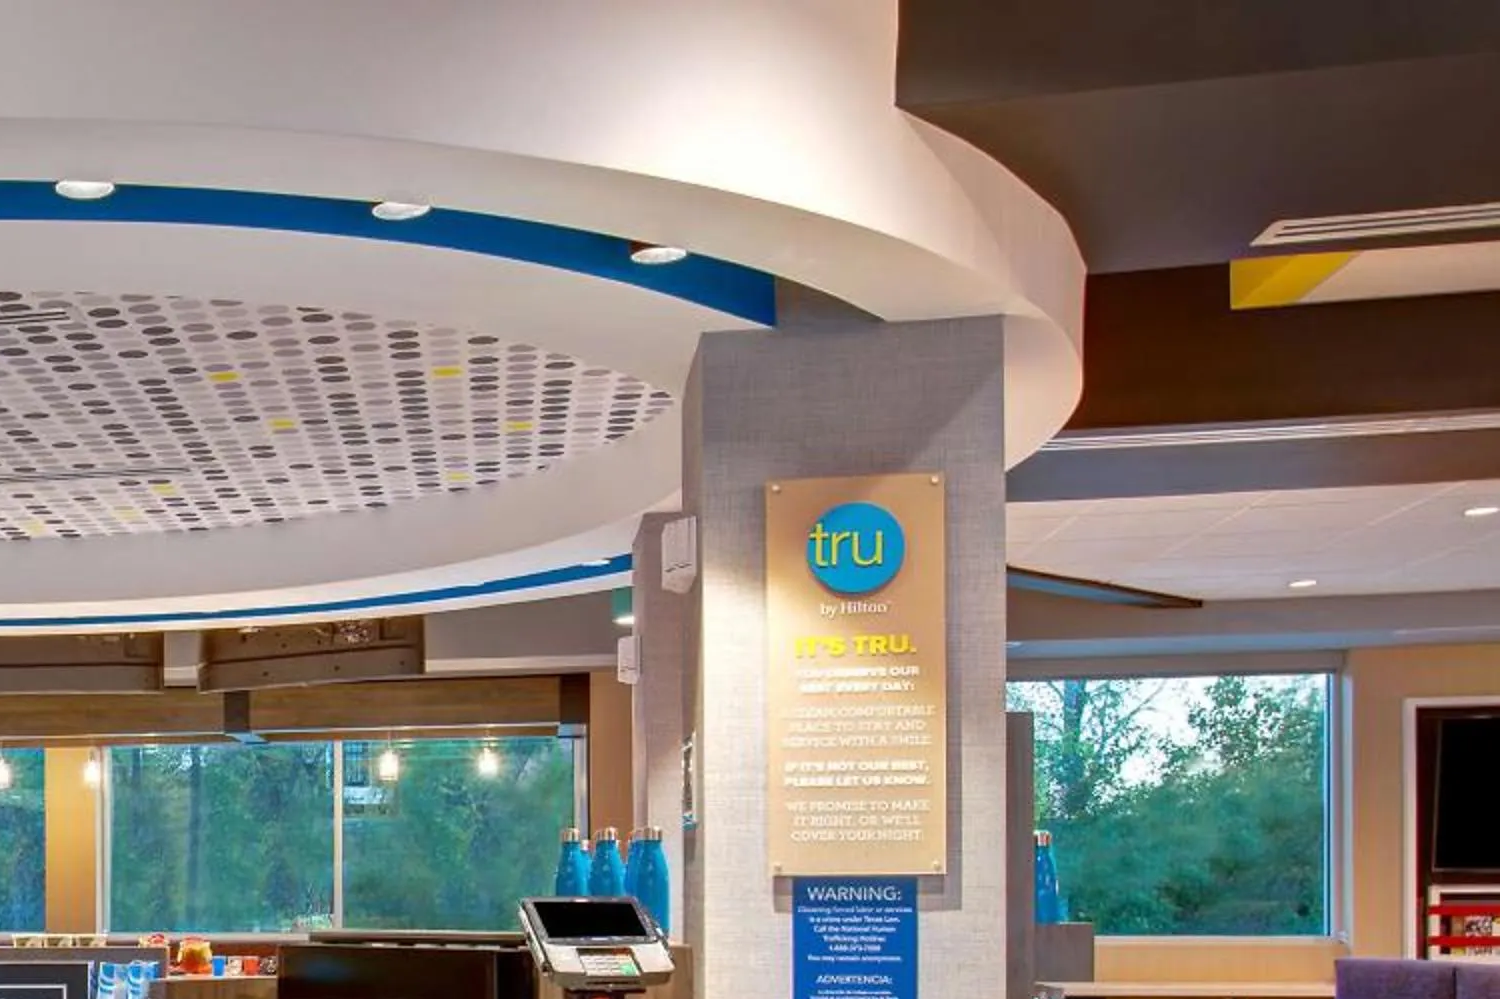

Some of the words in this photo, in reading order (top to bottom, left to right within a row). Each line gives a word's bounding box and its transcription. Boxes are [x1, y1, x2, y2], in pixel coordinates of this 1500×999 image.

[809, 523, 884, 566] tru
[820, 602, 837, 618] by
[840, 600, 888, 614] Hilton
[852, 634, 918, 656] TRU.
[889, 665, 920, 676] OUR
[895, 719, 927, 730] AND
[807, 885, 902, 901] WARNING:
